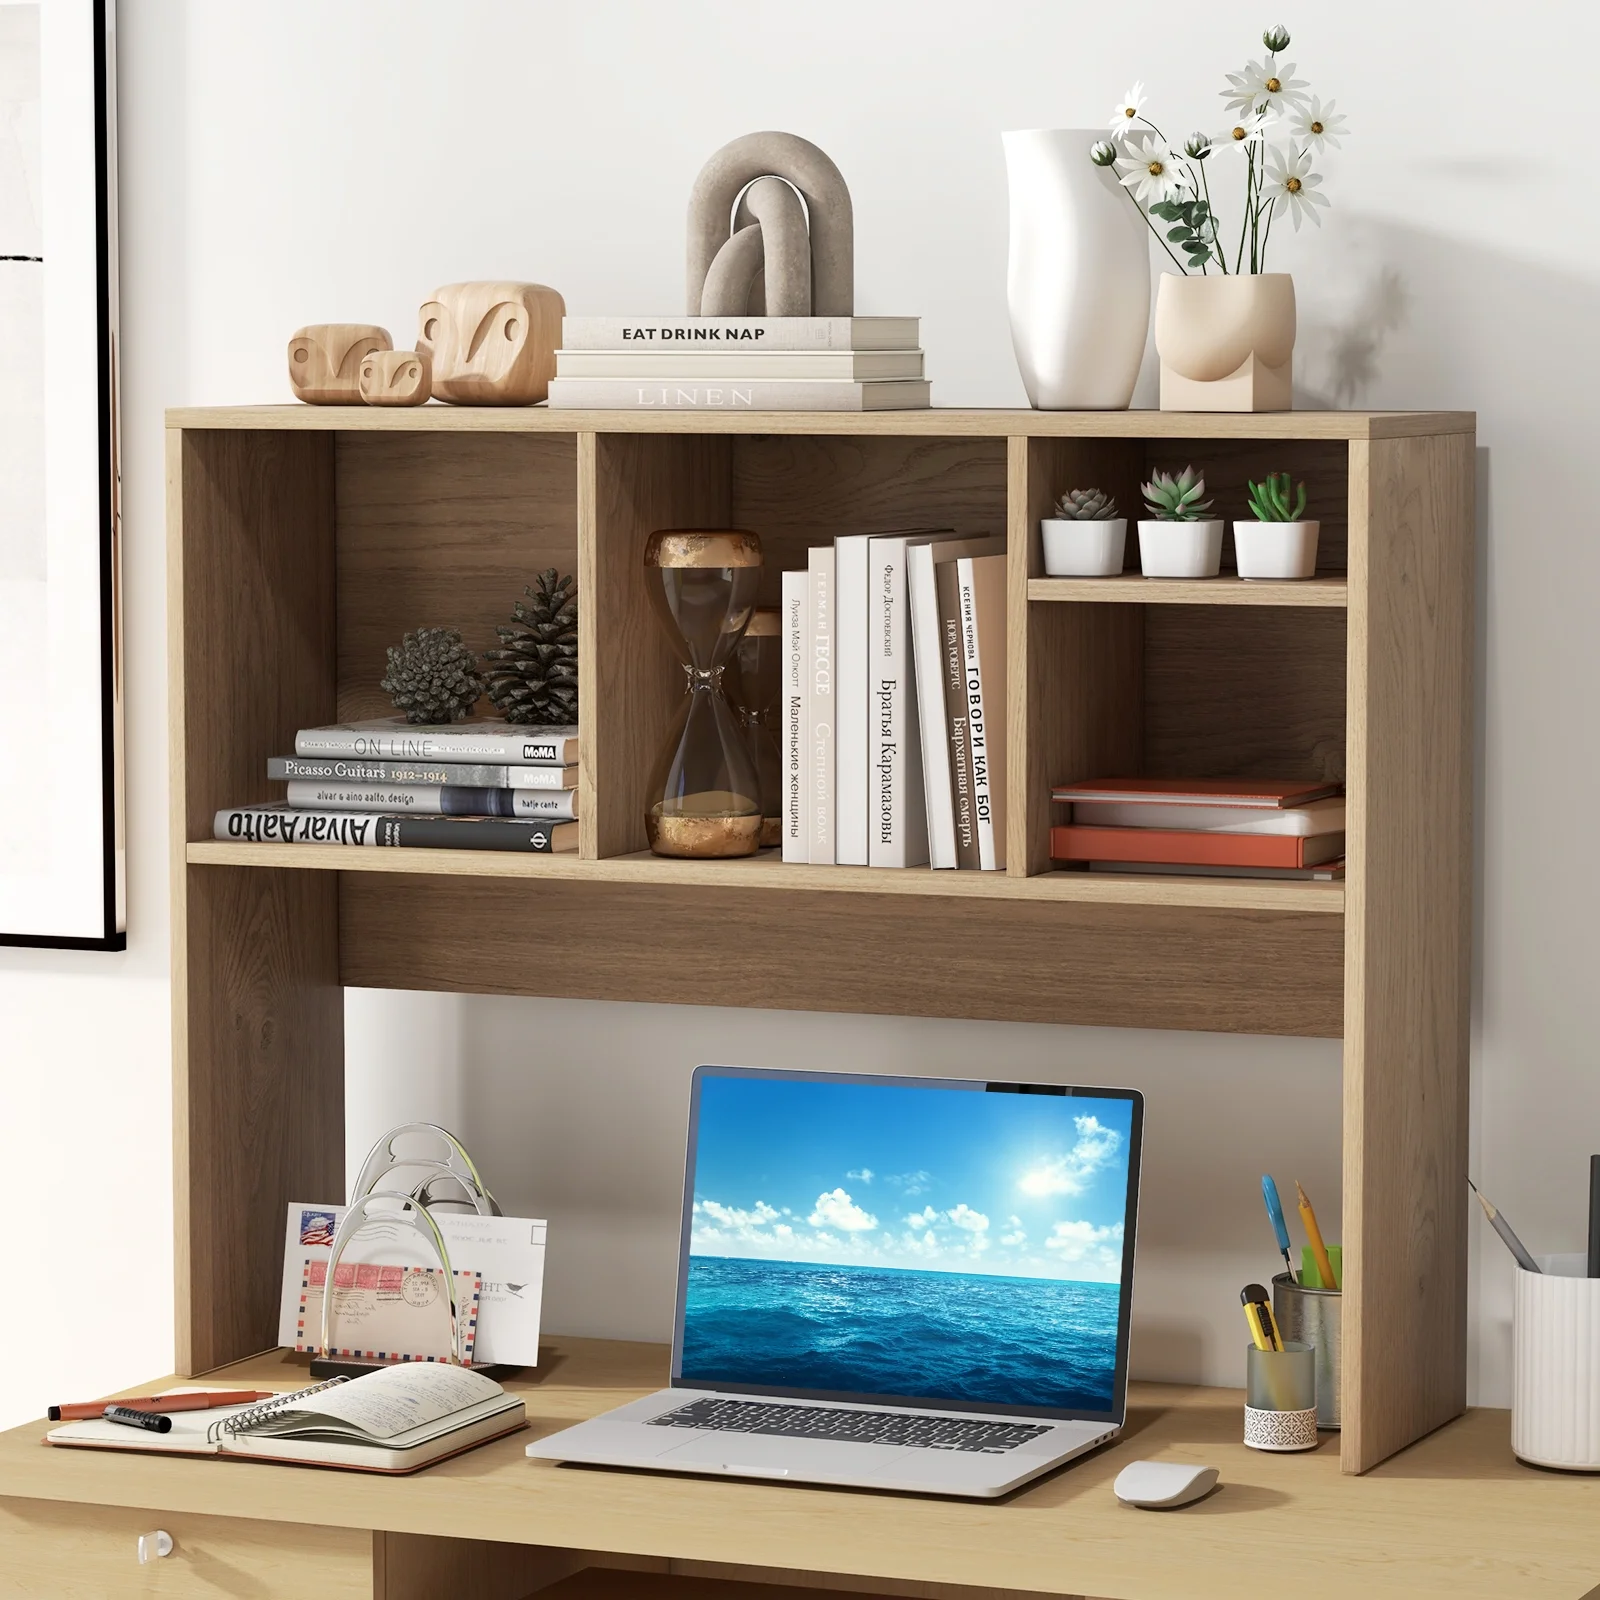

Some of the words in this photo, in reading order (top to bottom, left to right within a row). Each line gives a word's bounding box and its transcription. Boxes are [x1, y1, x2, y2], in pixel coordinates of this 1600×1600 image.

[622, 328, 657, 340] EAT
[661, 328, 721, 340] DRINK
[726, 328, 765, 340] NAP
[636, 388, 754, 406] LINEN
[790, 599, 800, 628] Луиза
[817, 572, 827, 629] ГЕРМАН
[963, 586, 972, 621] КСЕНИЯ
[791, 630, 801, 651] Мэй
[946, 620, 957, 644] НОРА
[965, 625, 975, 660] ЧЕРНОВА
[791, 653, 800, 688] Олкотт
[815, 634, 829, 695] ГЕССЕ
[950, 647, 960, 689] РОБЕРТС
[877, 679, 896, 737] Братья
[968, 668, 984, 747] ГОВОРИ
[354, 738, 381, 755] ON
[391, 740, 433, 757] LINE
[789, 696, 801, 770] Маленькие
[285, 761, 332, 776] Picasso
[335, 763, 386, 778] Guitars
[524, 746, 555, 759] MoMA
[815, 723, 831, 799] Степной
[951, 717, 968, 795] Бархатная
[524, 774, 556, 785] MoMA
[974, 756, 987, 786] КАК
[317, 790, 337, 801] alvar
[346, 792, 363, 802] aino
[388, 793, 414, 805] design
[522, 800, 538, 809] hatje
[540, 801, 558, 809] cantz
[789, 774, 800, 838] женщины
[877, 742, 896, 844] Карамазовы
[977, 795, 990, 825] БОГ
[957, 798, 973, 847] смерть
